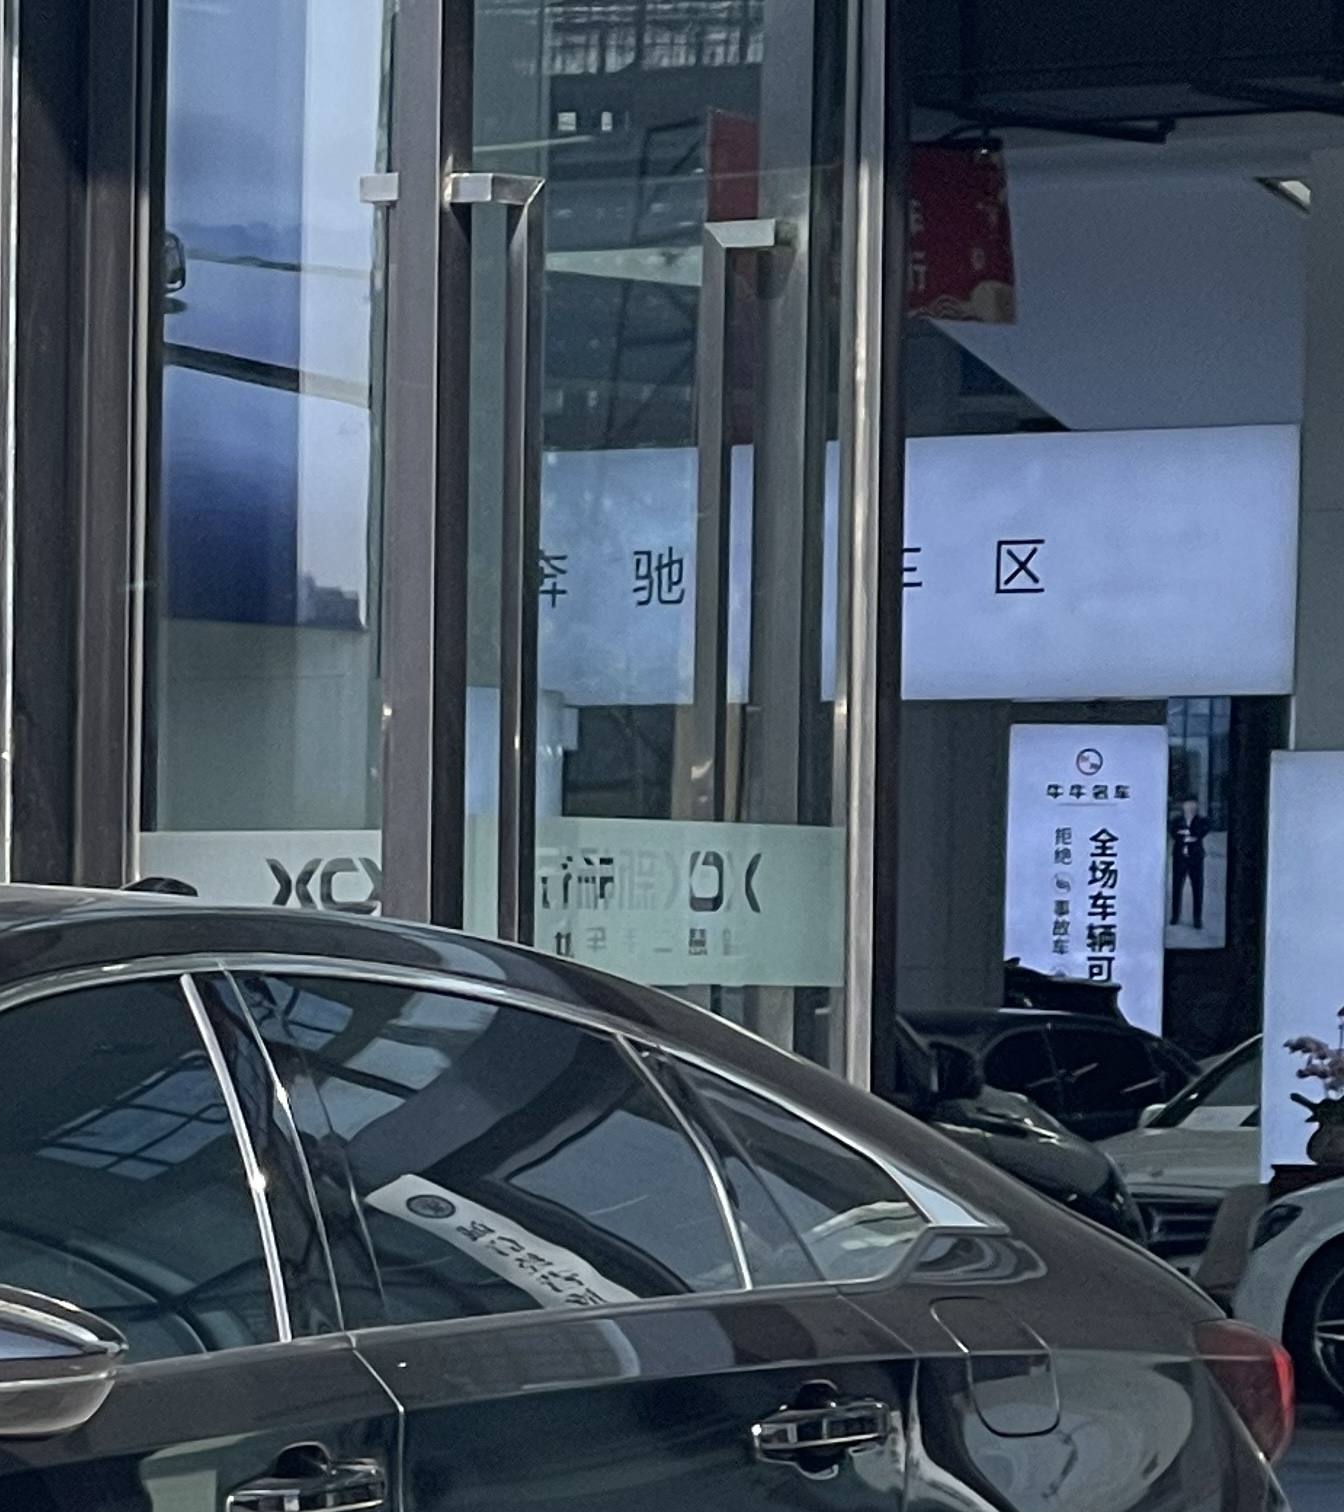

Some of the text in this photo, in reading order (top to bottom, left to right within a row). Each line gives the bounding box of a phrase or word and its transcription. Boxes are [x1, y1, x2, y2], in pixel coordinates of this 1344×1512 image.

[1086, 828, 1119, 982] 全场车辆可
